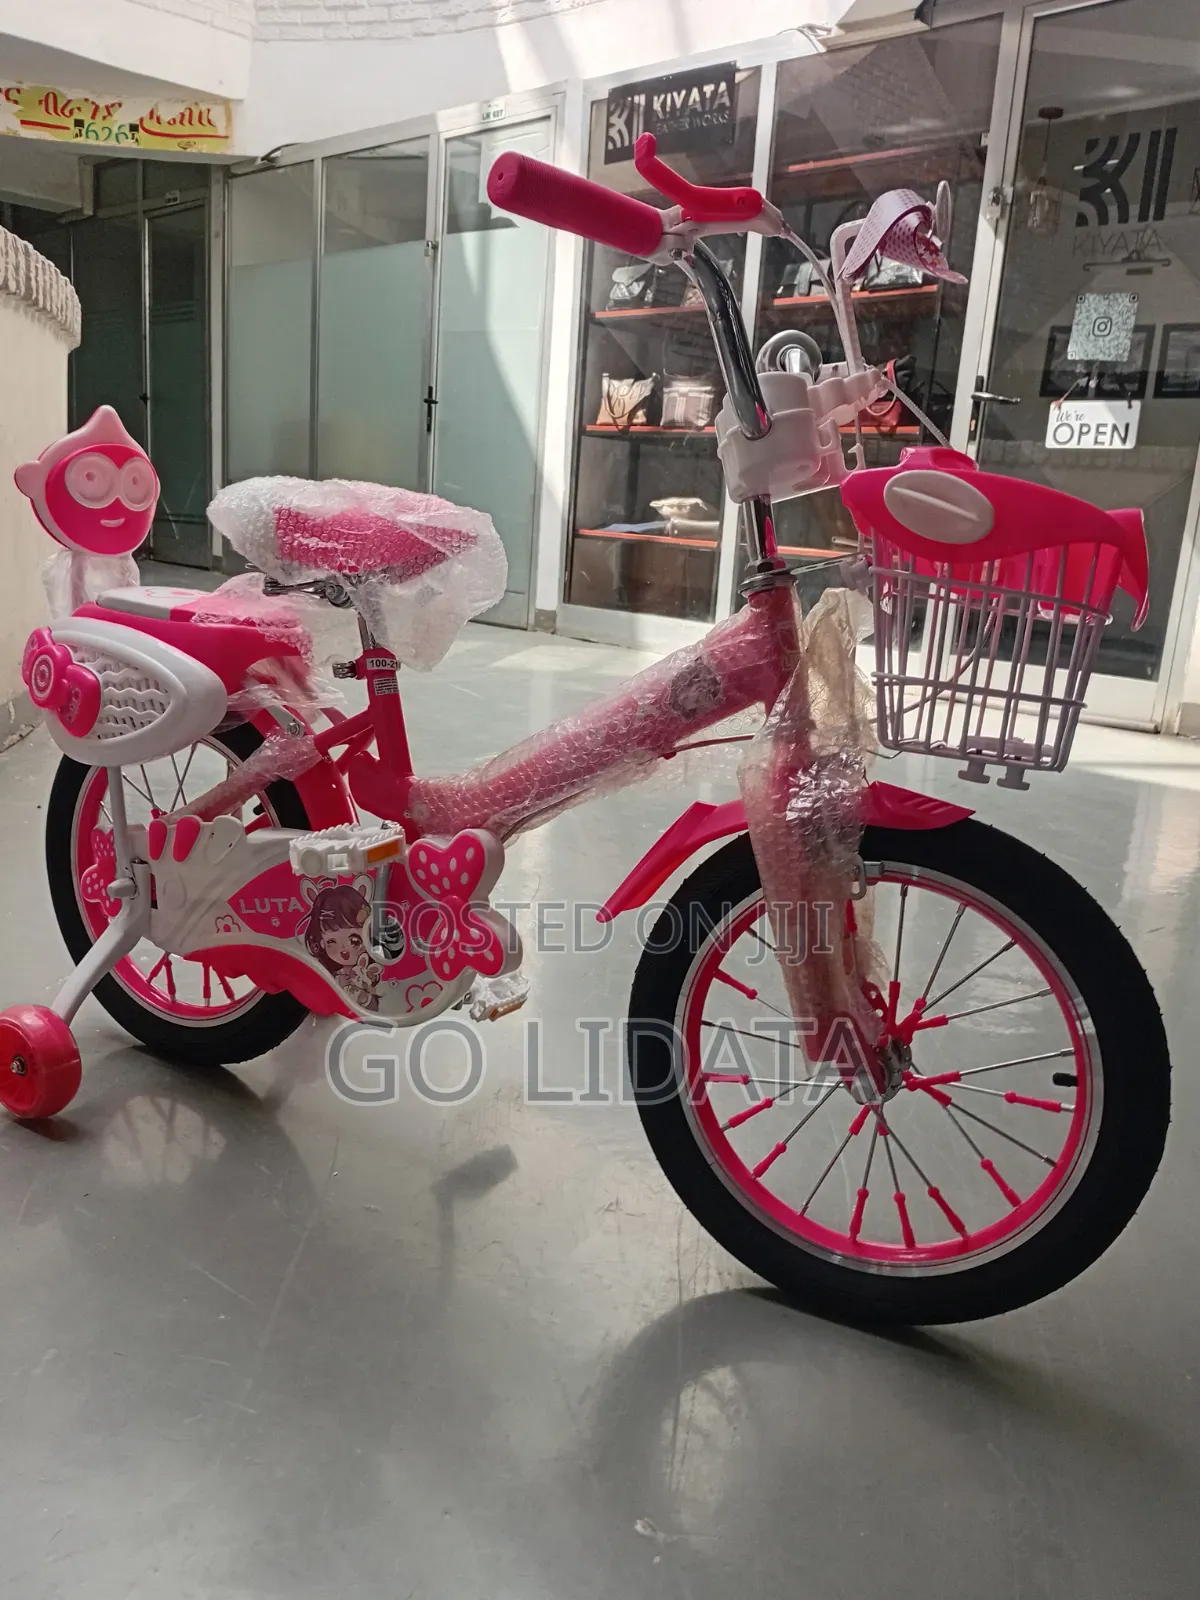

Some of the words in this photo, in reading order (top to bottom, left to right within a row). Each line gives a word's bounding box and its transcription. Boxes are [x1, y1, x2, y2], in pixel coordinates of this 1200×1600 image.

[653, 81, 730, 119] KIYATA
[1072, 228, 1163, 258] KIYATA
[1055, 409, 1086, 423] We're
[1053, 422, 1130, 446] OPEN
[239, 897, 305, 914] LUTA
